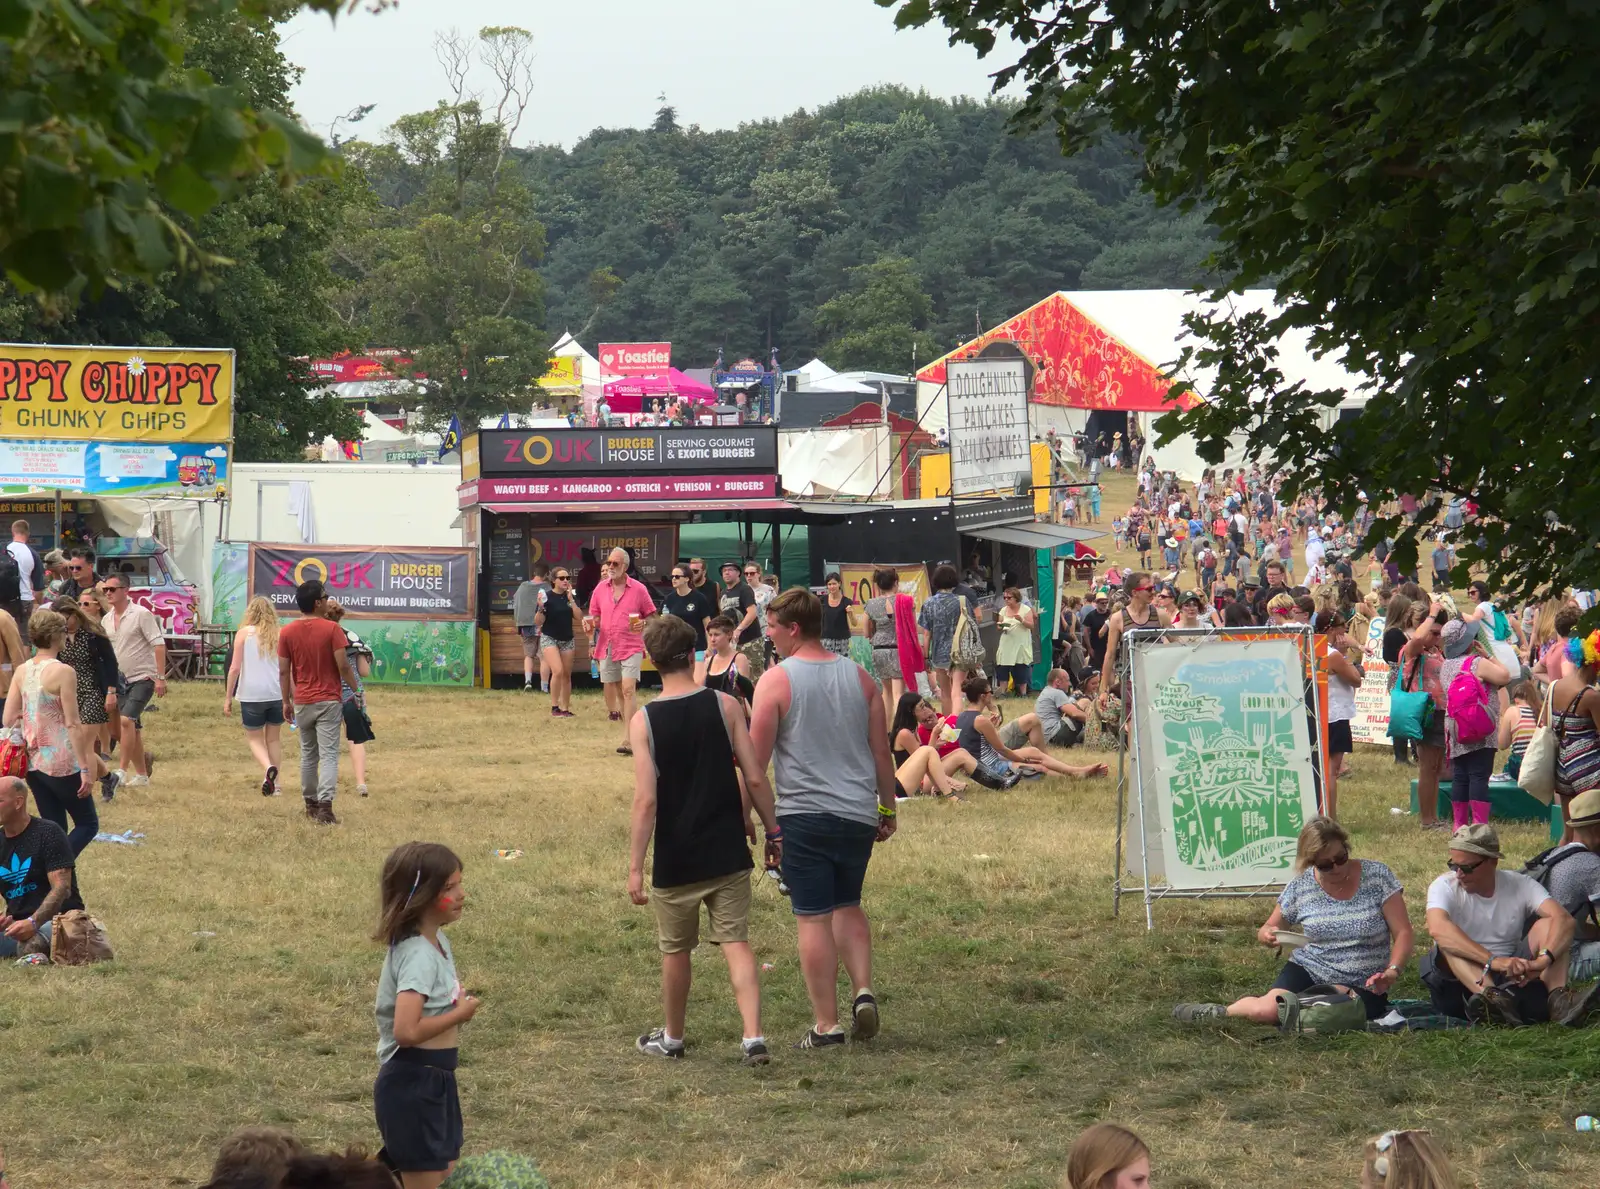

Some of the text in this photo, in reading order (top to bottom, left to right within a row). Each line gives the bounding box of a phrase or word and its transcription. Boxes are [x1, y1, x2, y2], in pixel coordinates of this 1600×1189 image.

[618, 349, 668, 363] Toasties
[81, 361, 221, 405] CHIPPY
[956, 371, 1018, 399] DOUGHNUTS
[17, 408, 107, 429] CHUNKY
[964, 403, 1016, 432] PANCAKES
[608, 438, 655, 449] BURGER
[666, 437, 755, 448] SERVING GOURMET
[503, 435, 596, 466] ZOUK
[608, 449, 655, 462] HOUSE
[667, 448, 755, 459] & EXOTIC BURGERS
[960, 434, 1023, 466] MILKSHAKES
[494, 481, 764, 494] WAGYU BEEF KANGAROO OSTRICH VENISON BURGERS
[600, 537, 649, 548] BURGER
[600, 548, 648, 560] HSE
[271, 558, 376, 589] ZOUK
[390, 563, 443, 576] BURGER
[390, 576, 442, 590] HOUSE
[374, 597, 407, 606] INDIAN
[410, 597, 451, 607] BURGERS
[1154, 699, 1203, 707] FLAVOUR
[1242, 696, 1291, 708] GOOD FOR YOU
[1213, 750, 1248, 760] TASTY
[1228, 846, 1261, 870] PORTION
[6, 882, 37, 900] adidas
